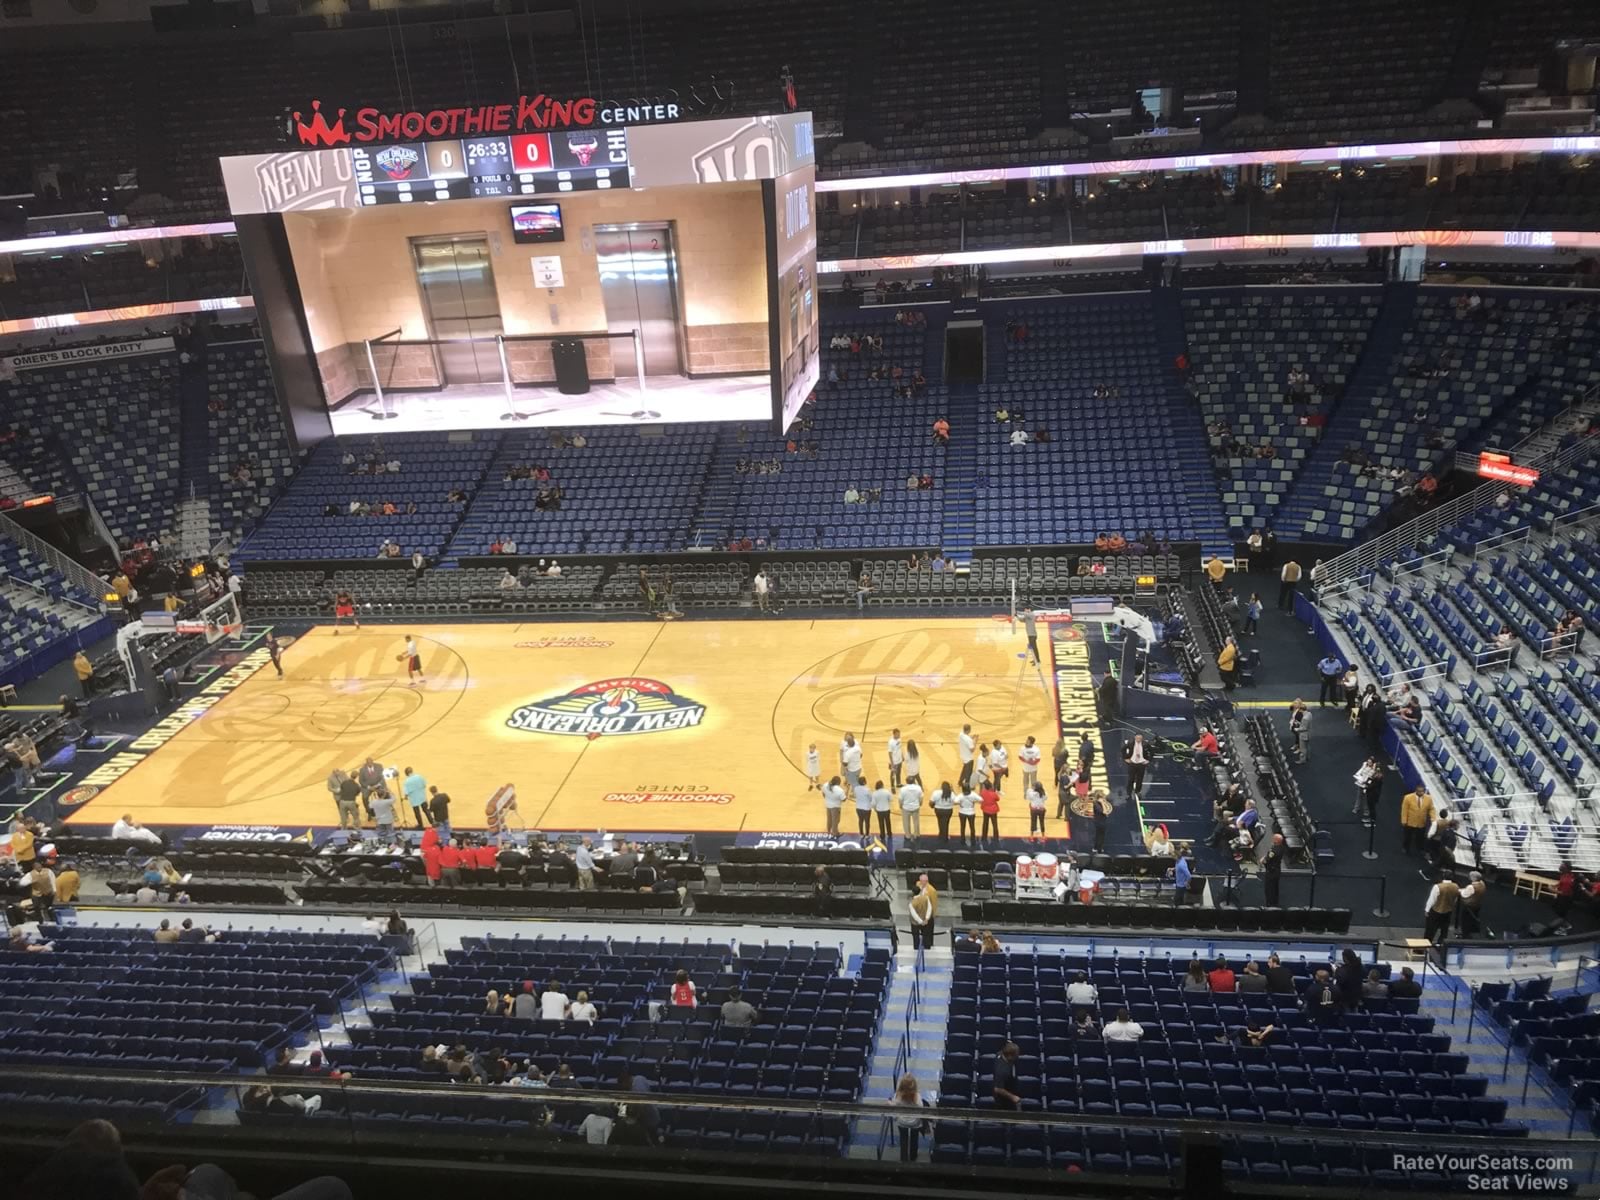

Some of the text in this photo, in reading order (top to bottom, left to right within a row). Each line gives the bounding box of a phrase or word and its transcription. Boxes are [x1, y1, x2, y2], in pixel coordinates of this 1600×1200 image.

[355, 104, 512, 142] SMOOTHIE
[601, 104, 679, 123] CENTER
[468, 142, 507, 158] 26:33
[526, 143, 538, 162] 0
[606, 130, 627, 163] CHI
[353, 148, 373, 183] NOP
[441, 150, 452, 168] 0
[1504, 231, 1519, 246] DO
[1520, 231, 1530, 245] IT
[34, 316, 48, 330] DO
[61, 346, 101, 361] BLOCK
[106, 342, 143, 355] PARTY
[1053, 641, 1091, 667] NEW
[587, 678, 663, 692] PELICANS
[1056, 669, 1099, 724] ORLEANS
[508, 706, 706, 734] NEW ORLEANS
[78, 752, 147, 785] NEW
[129, 696, 221, 750] ORLEANS
[650, 794, 735, 805] SMOOTHIE
